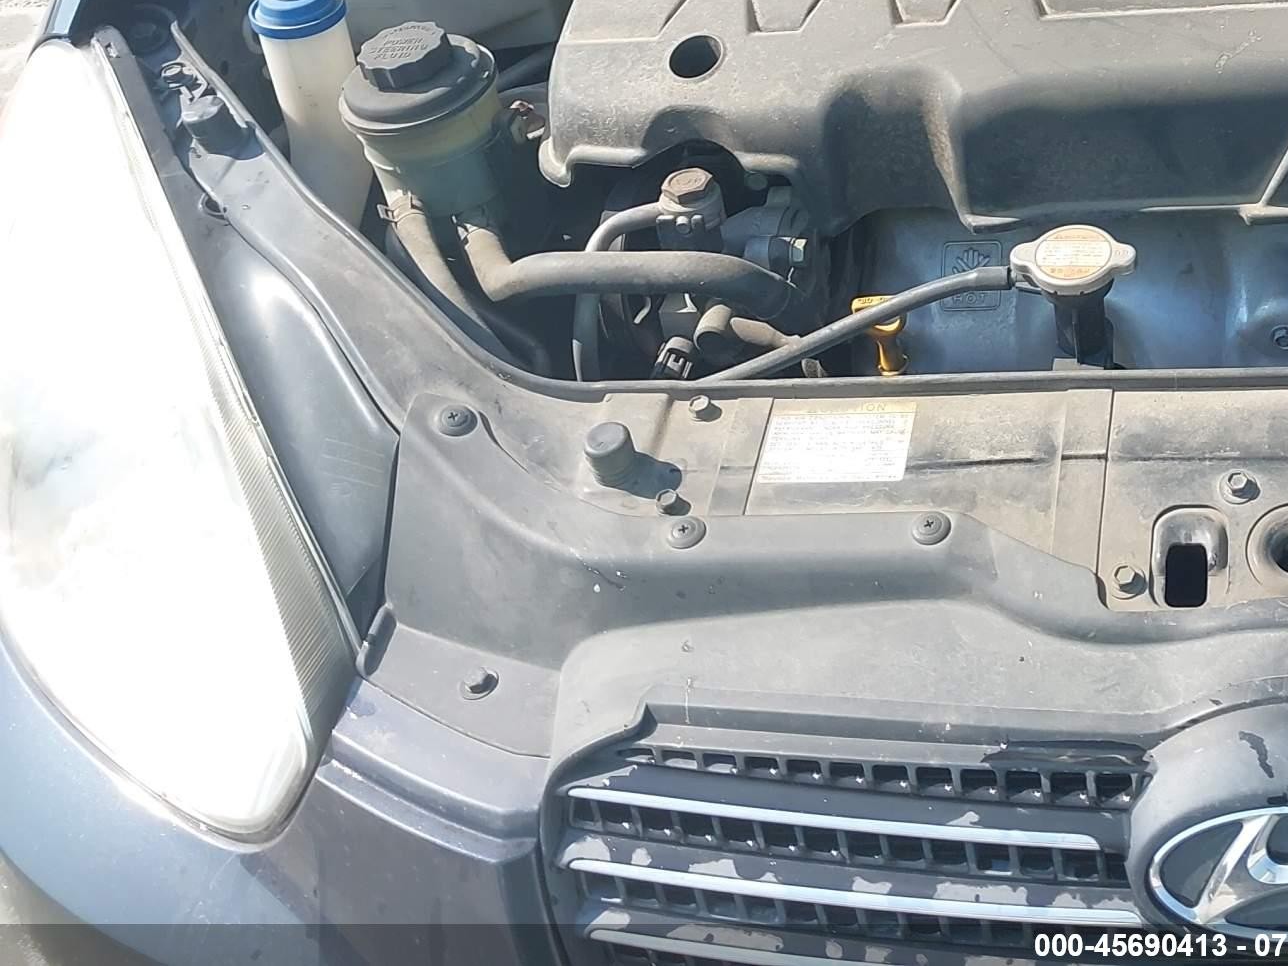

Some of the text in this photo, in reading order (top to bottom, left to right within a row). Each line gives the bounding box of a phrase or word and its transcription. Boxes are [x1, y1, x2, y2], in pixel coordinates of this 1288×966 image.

[384, 37, 424, 46] POWER
[368, 44, 429, 54] STEERING
[374, 52, 412, 60] FLUID
[952, 290, 985, 305] HOT
